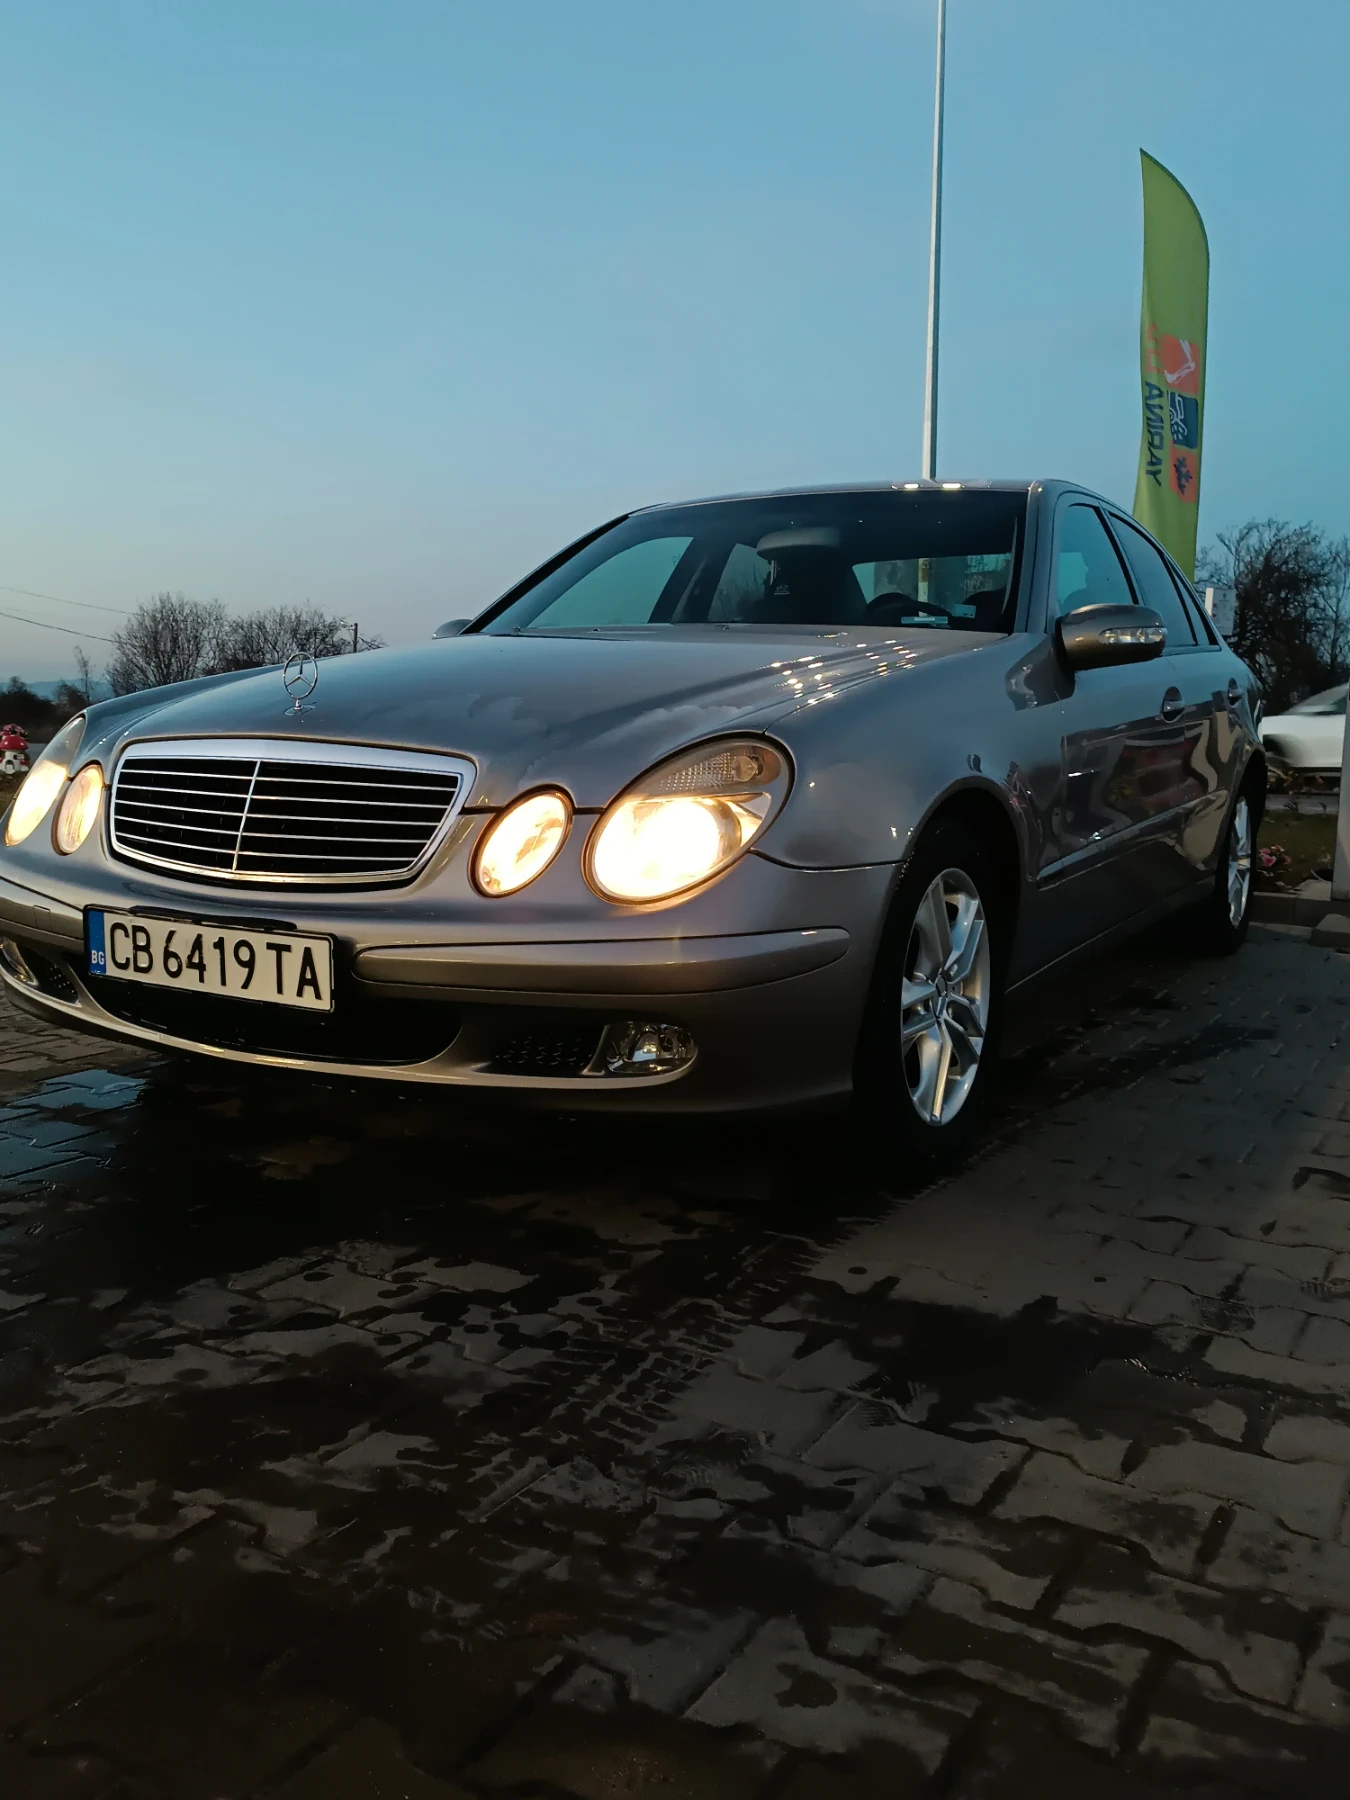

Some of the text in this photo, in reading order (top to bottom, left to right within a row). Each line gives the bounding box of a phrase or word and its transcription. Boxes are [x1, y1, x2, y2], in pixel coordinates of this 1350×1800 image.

[91, 951, 105, 965] BG
[110, 922, 324, 1001] CB 6419 TA
